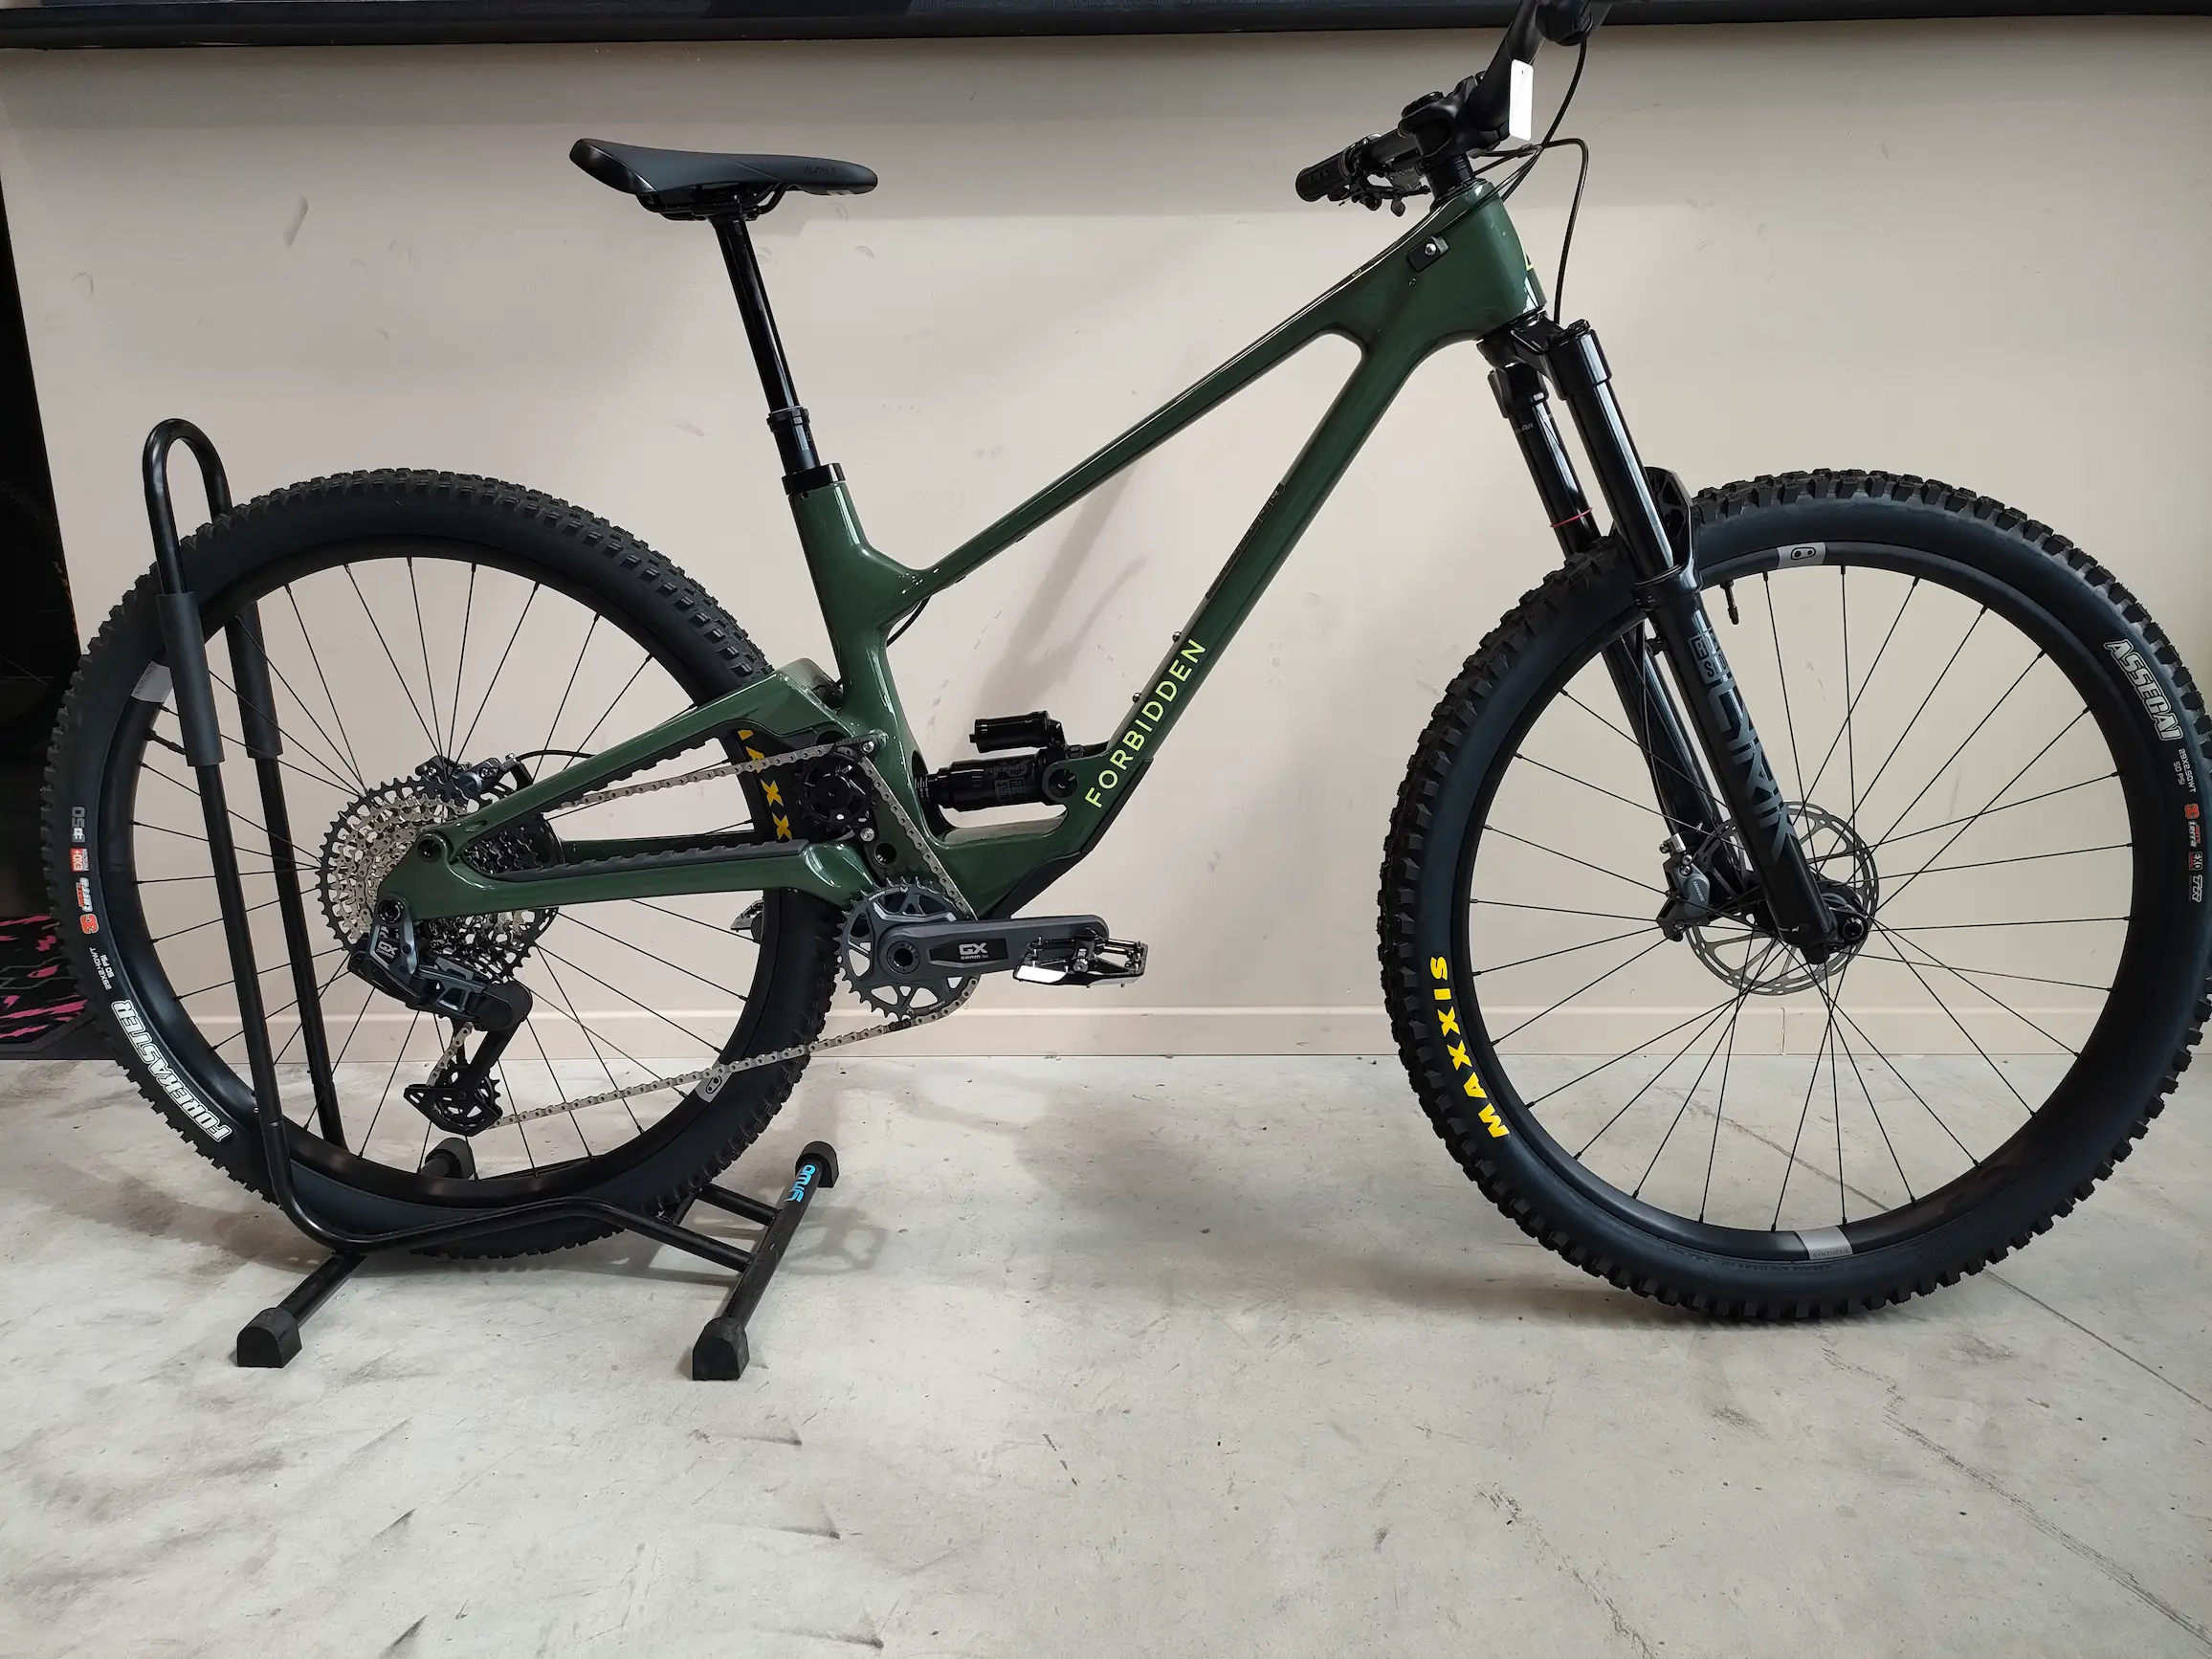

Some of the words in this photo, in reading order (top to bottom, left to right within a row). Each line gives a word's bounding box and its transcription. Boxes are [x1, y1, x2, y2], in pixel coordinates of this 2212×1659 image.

[2104, 639, 2184, 741] ASSEGAI
[1084, 638, 1206, 808] FORBIDDEN
[100, 954, 111, 967] PSI
[104, 966, 116, 979] 50
[377, 940, 398, 955] GX
[958, 942, 988, 956] GX
[111, 999, 232, 1143] FOREKASTER
[1429, 956, 1511, 1139] MAXXIS
